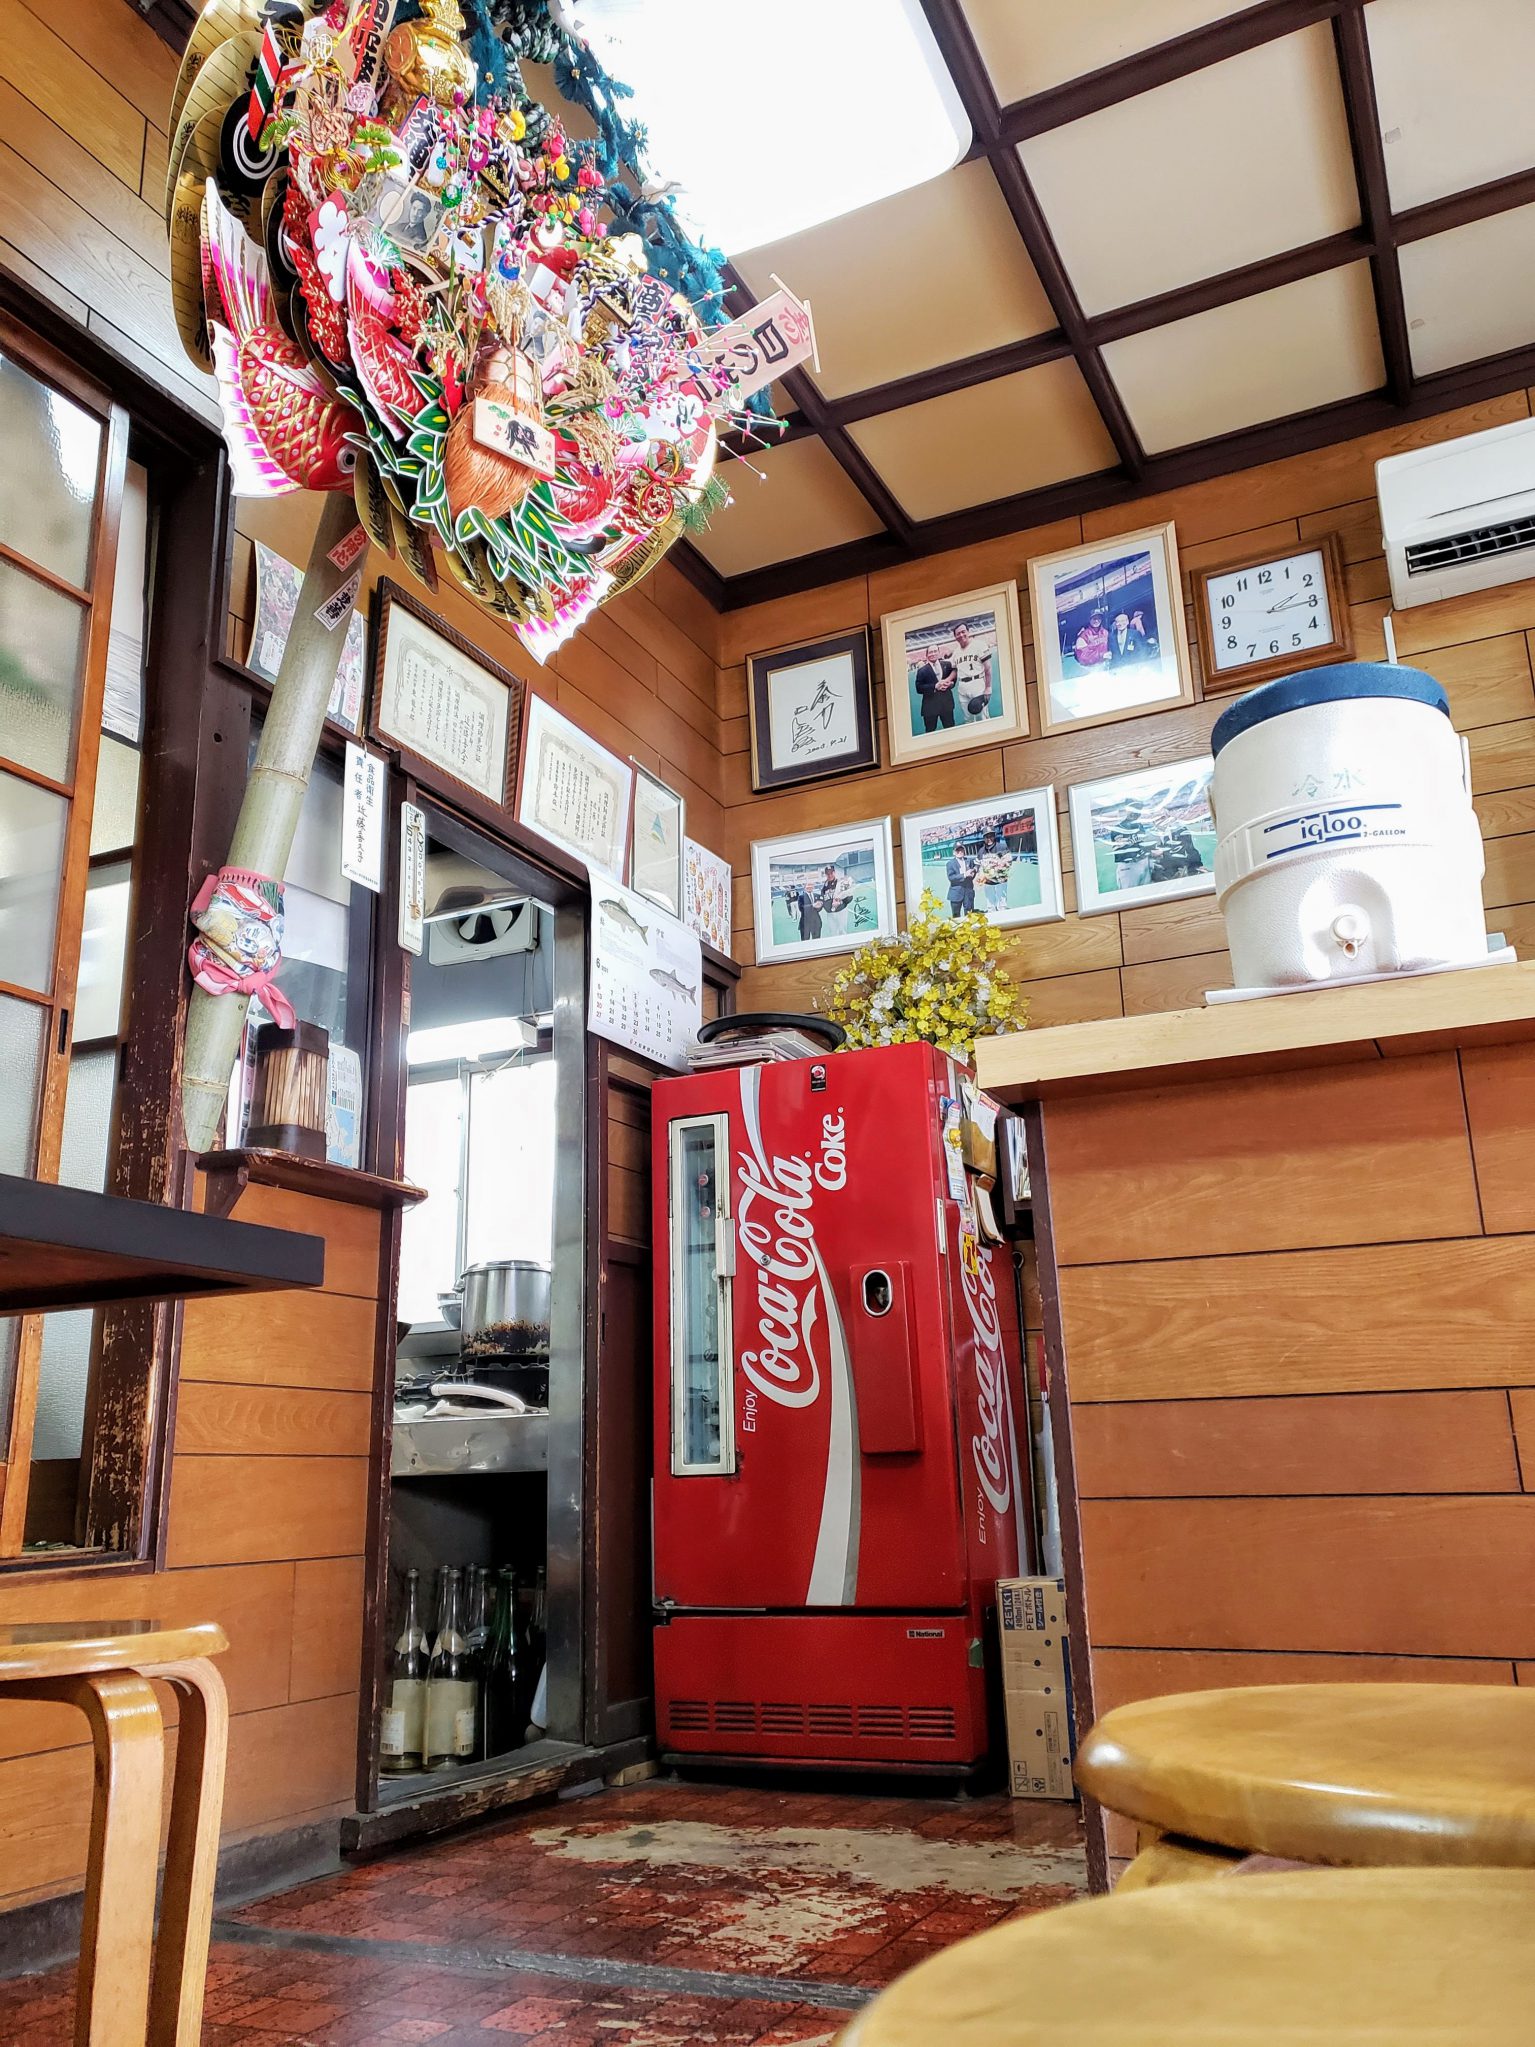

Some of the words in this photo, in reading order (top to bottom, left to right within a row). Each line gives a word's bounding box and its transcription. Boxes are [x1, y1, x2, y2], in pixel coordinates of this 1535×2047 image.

[1257, 570, 1272, 585] 12
[1284, 567, 1290, 580] 1
[1302, 573, 1313, 588] 2
[1236, 579, 1248, 592] 11
[1221, 594, 1235, 609] 10
[1308, 594, 1318, 608] 3
[1222, 616, 1232, 630] 9
[1308, 616, 1318, 629] 4
[1227, 635, 1238, 649] 8
[1269, 640, 1280, 653] 6
[1292, 633, 1302, 646] 5
[1246, 644, 1257, 658] 7
[1291, 767, 1366, 798] 冷水
[1300, 814, 1362, 841] igloo
[1363, 829, 1406, 838] 2-GALLON
[595, 957, 601, 969] 6
[814, 1113, 847, 1191] Coke
[737, 1150, 821, 1409] Coca-Cola
[742, 1389, 758, 1433] Enjoy
[978, 1486, 988, 1545] Enjoy
[1024, 1587, 1034, 1631] PETボトル
[915, 1630, 943, 1638] National
